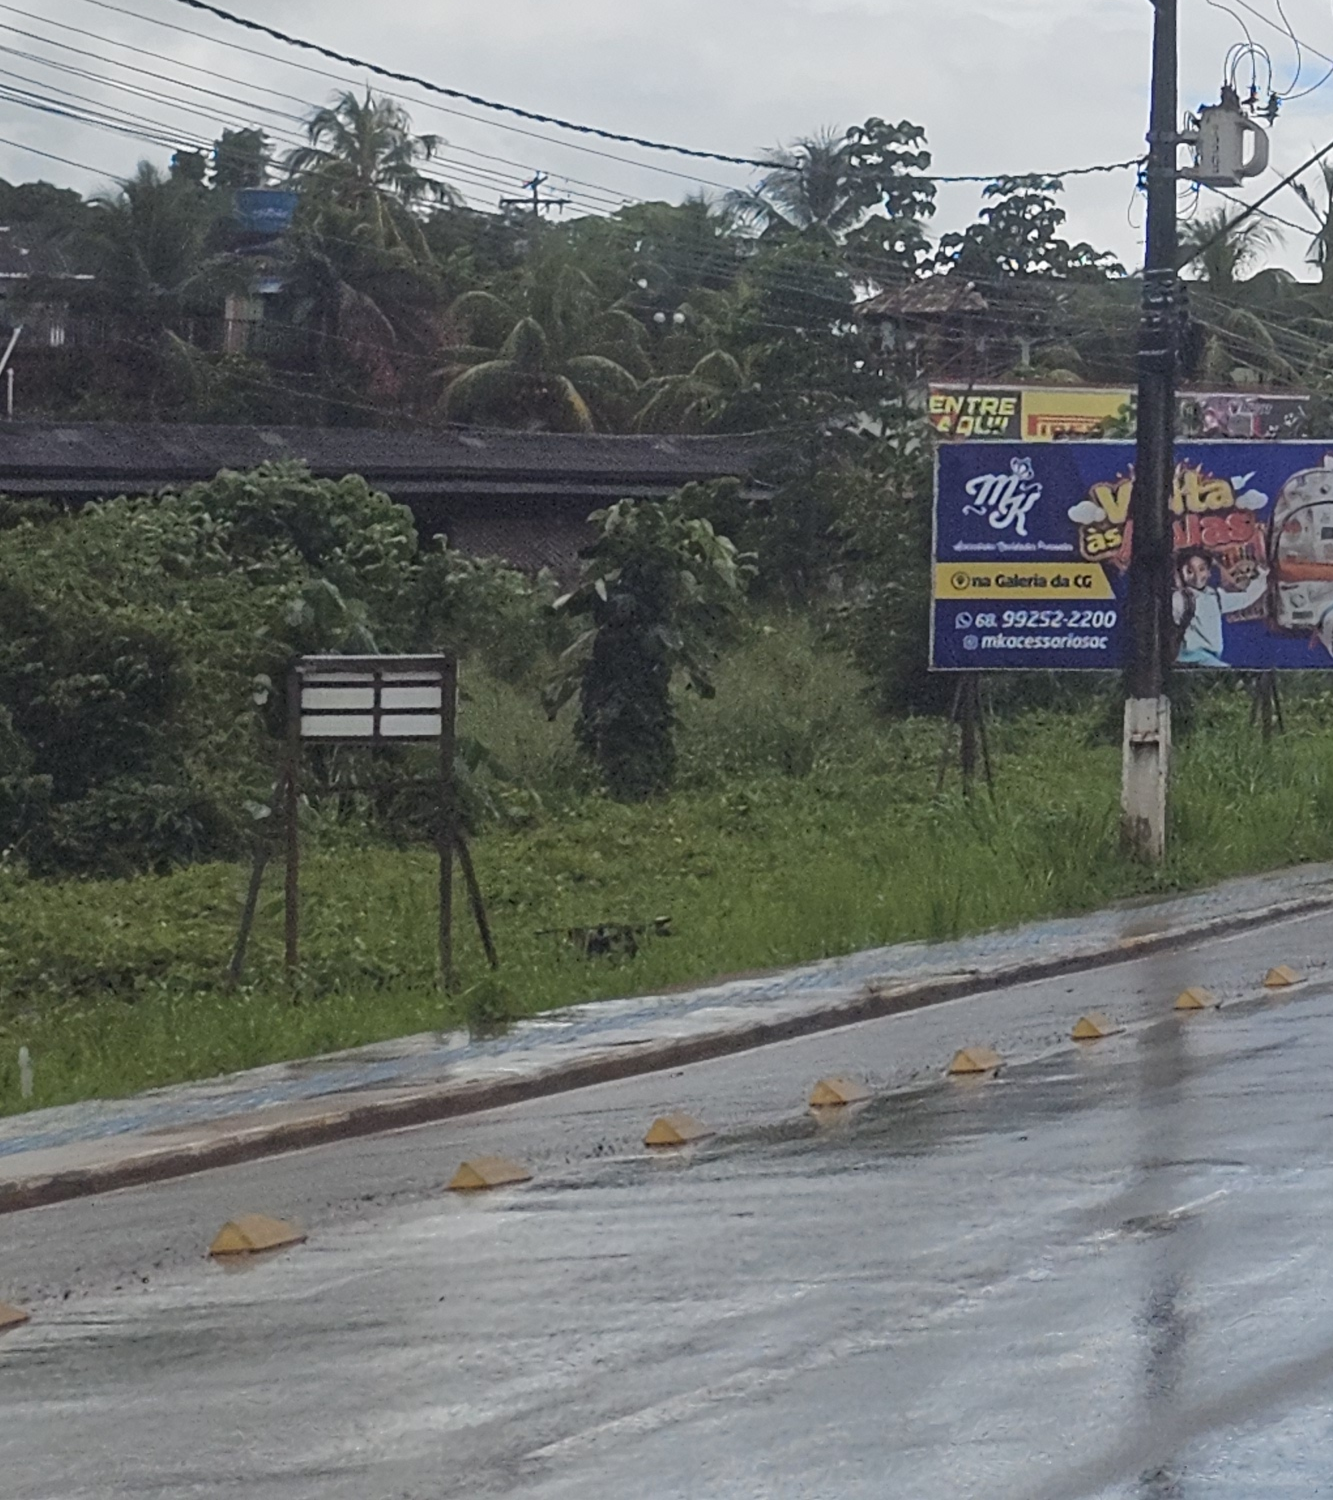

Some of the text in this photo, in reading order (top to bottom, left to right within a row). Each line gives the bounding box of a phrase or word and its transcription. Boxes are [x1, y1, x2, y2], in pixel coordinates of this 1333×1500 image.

[929, 395, 1017, 416] ENTRE
[1094, 469, 1234, 523] Vlta
[971, 573, 1092, 589] na Galeria da CG
[1001, 610, 1118, 629] 99252-2200
